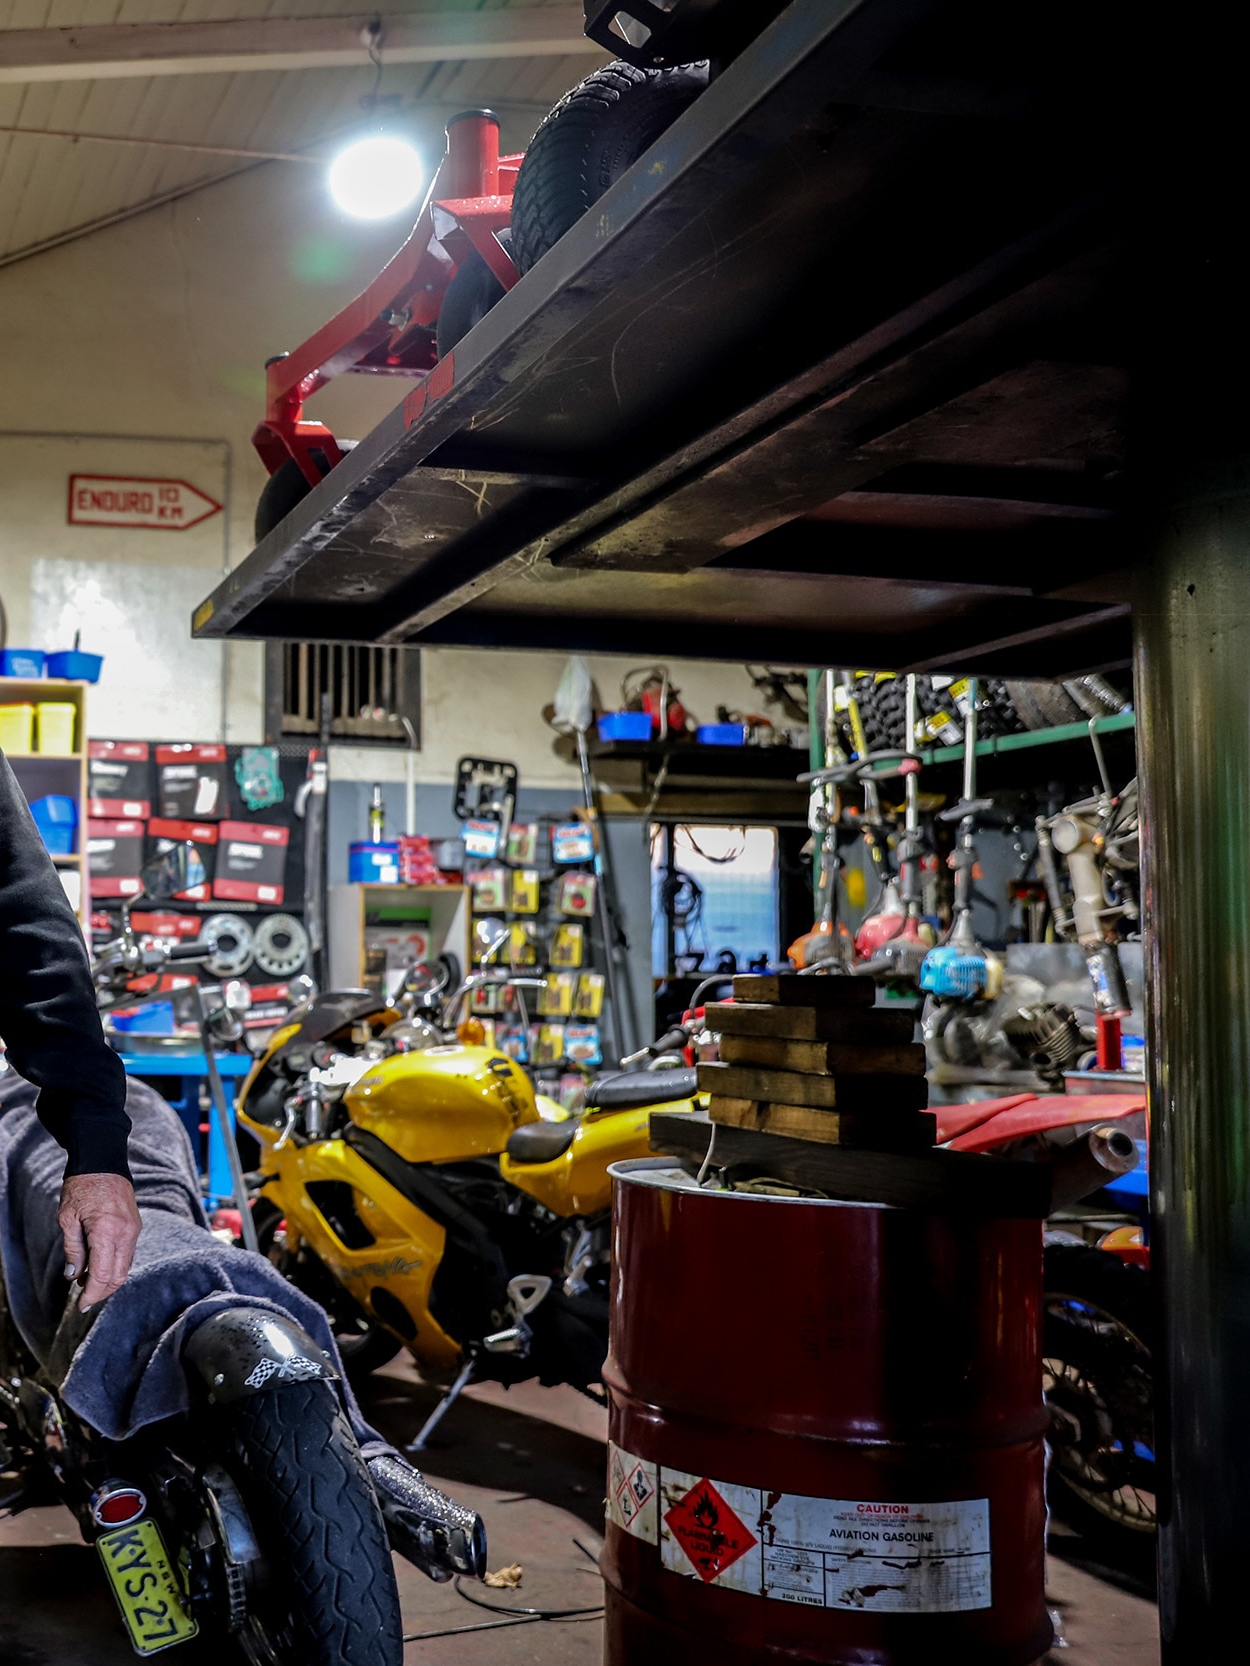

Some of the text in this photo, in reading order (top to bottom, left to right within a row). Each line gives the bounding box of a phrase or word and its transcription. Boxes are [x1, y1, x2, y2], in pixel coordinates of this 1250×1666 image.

[77, 489, 153, 514] ENDURO
[159, 487, 179, 502] 10
[157, 506, 183, 519] KM
[856, 1504, 909, 1515] CAUTION
[829, 1528, 934, 1542] AVIATION GASOLINE
[691, 1540, 723, 1556] LIQUID
[157, 1560, 176, 1594] NSW
[797, 1595, 823, 1605] LITRES
